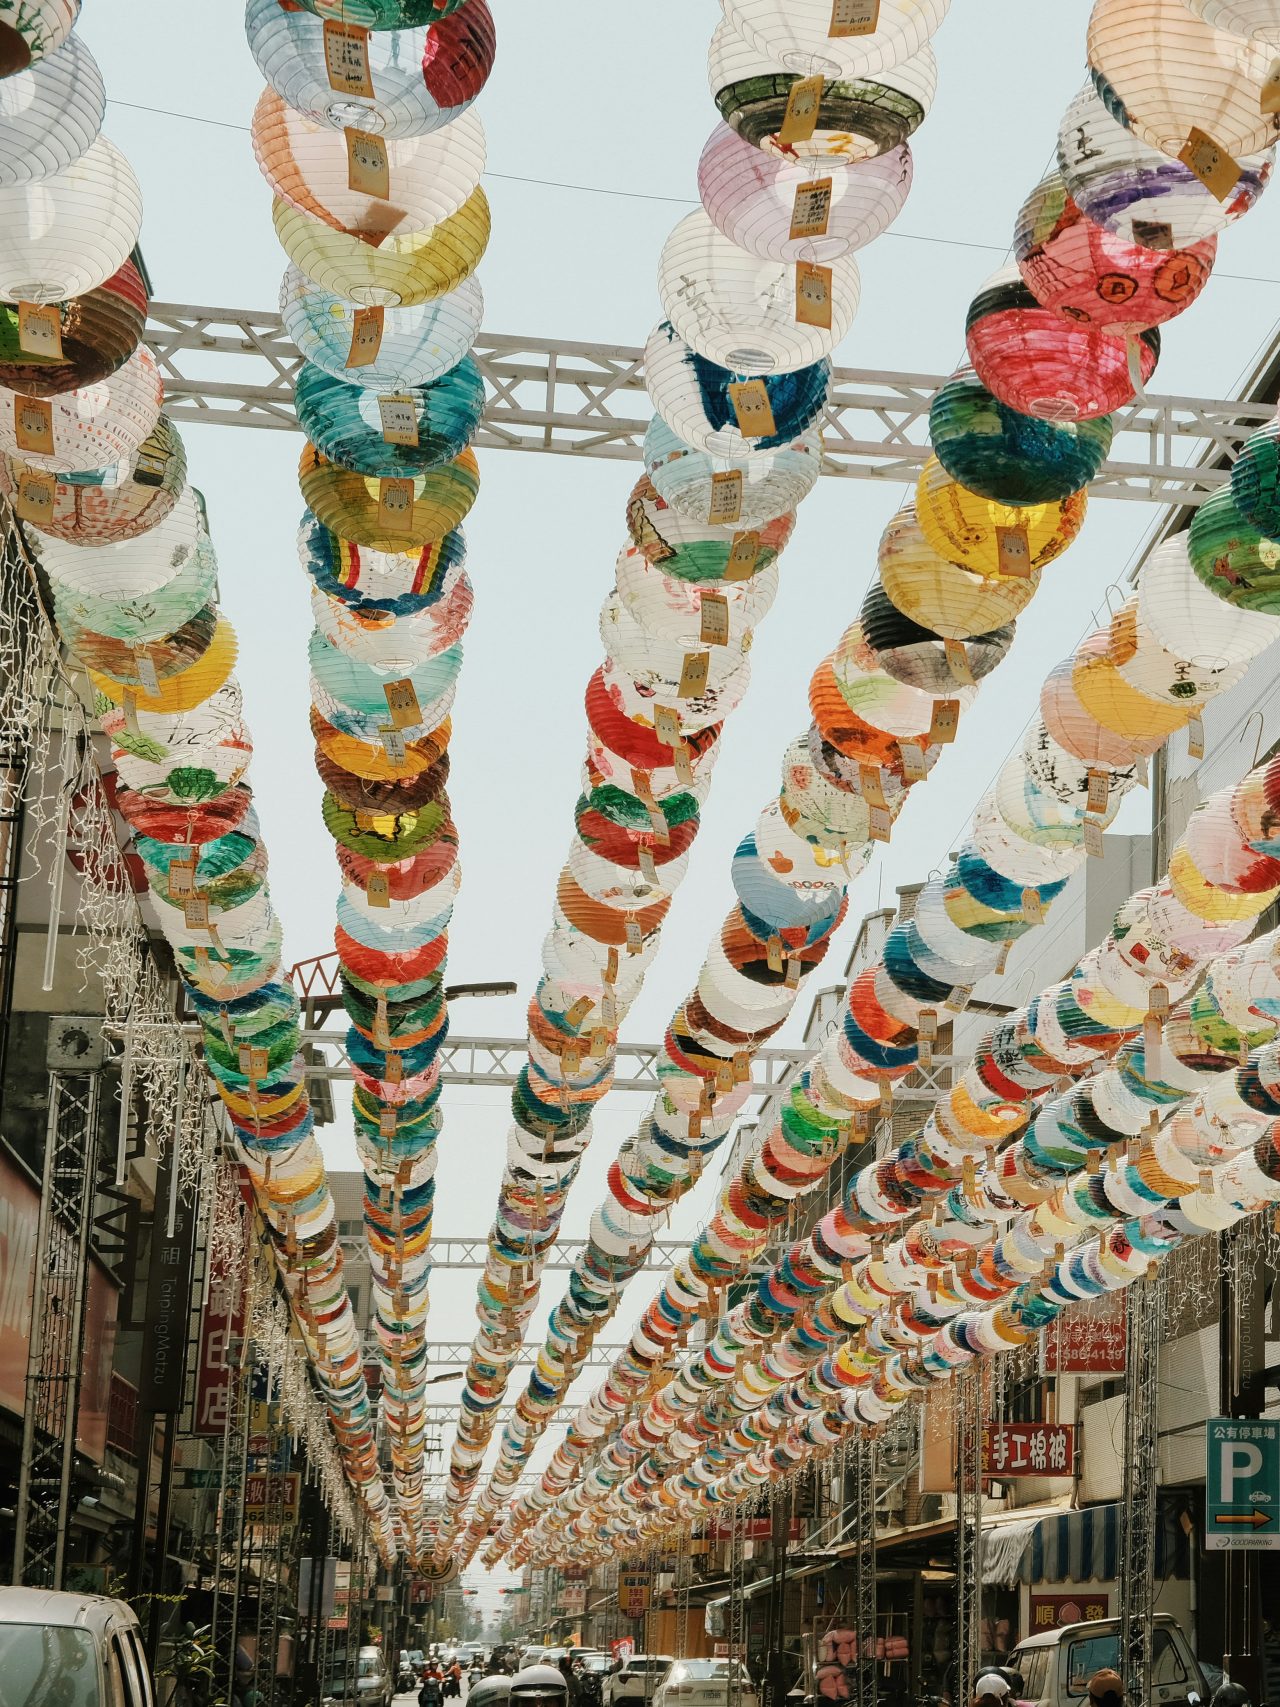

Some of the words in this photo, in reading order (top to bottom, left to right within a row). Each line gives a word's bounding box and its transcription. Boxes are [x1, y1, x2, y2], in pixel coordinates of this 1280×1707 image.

[152, 1278, 177, 1386] TaipingMatzu
[992, 1428, 1067, 1470] 手工棉被
[1214, 1426, 1276, 1439] 公有停車場
[1220, 1441, 1263, 1503] P
[1035, 1605, 1055, 1625] 順
[1085, 1604, 1105, 1620] 發
